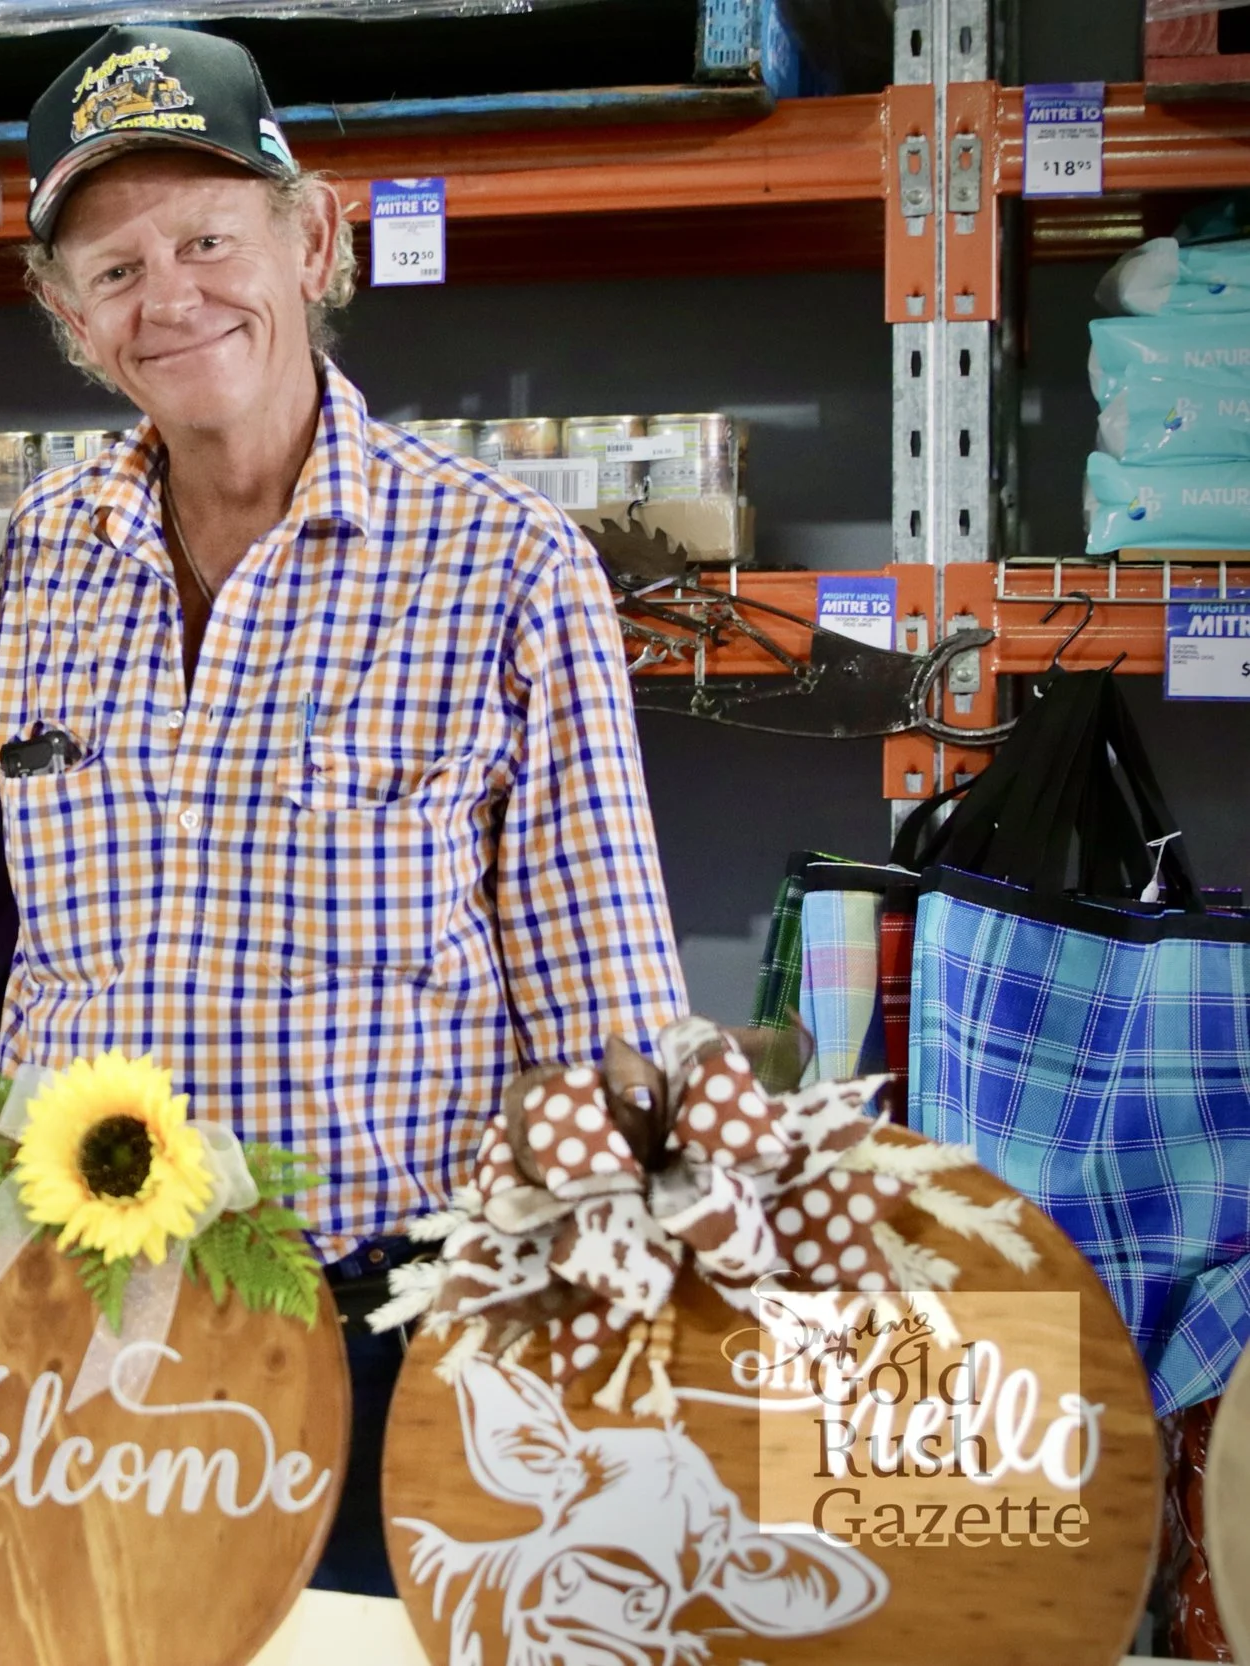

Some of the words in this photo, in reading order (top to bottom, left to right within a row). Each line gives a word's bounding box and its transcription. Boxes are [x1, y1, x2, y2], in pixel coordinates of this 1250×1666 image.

[1029, 108, 1077, 121] MITRE
[1081, 107, 1101, 120] 10
[375, 201, 419, 215] MITRE
[422, 200, 440, 213] 10
[821, 592, 855, 601] MIGHTY
[821, 600, 868, 614] MITRE
[871, 601, 891, 615] 10
